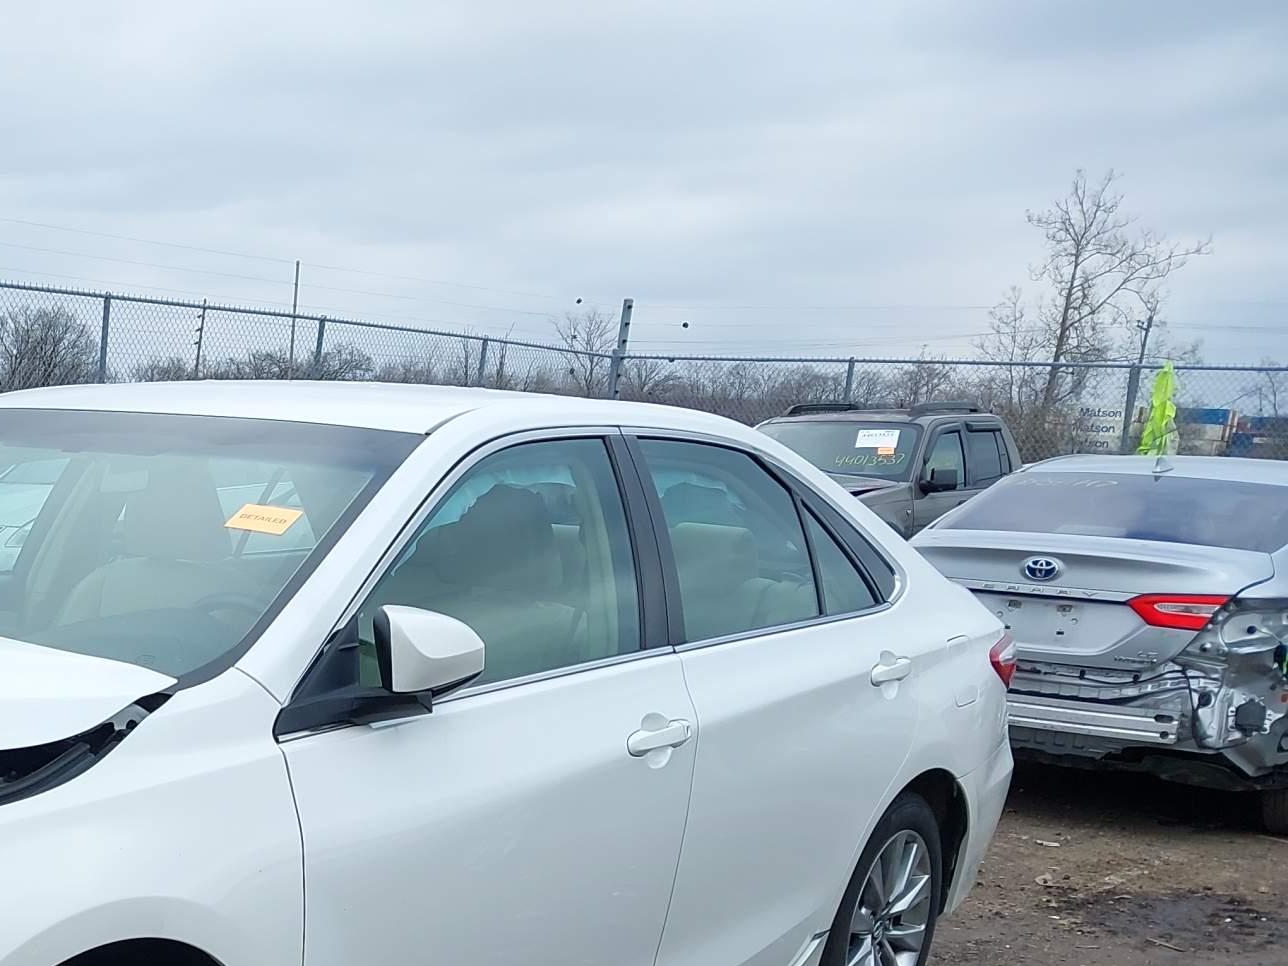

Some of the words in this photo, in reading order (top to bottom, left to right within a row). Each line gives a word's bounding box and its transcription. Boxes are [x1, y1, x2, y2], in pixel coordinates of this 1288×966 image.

[1080, 407, 1122, 418] Matson
[835, 453, 905, 467] 44013537
[239, 513, 288, 525] DETAILED
